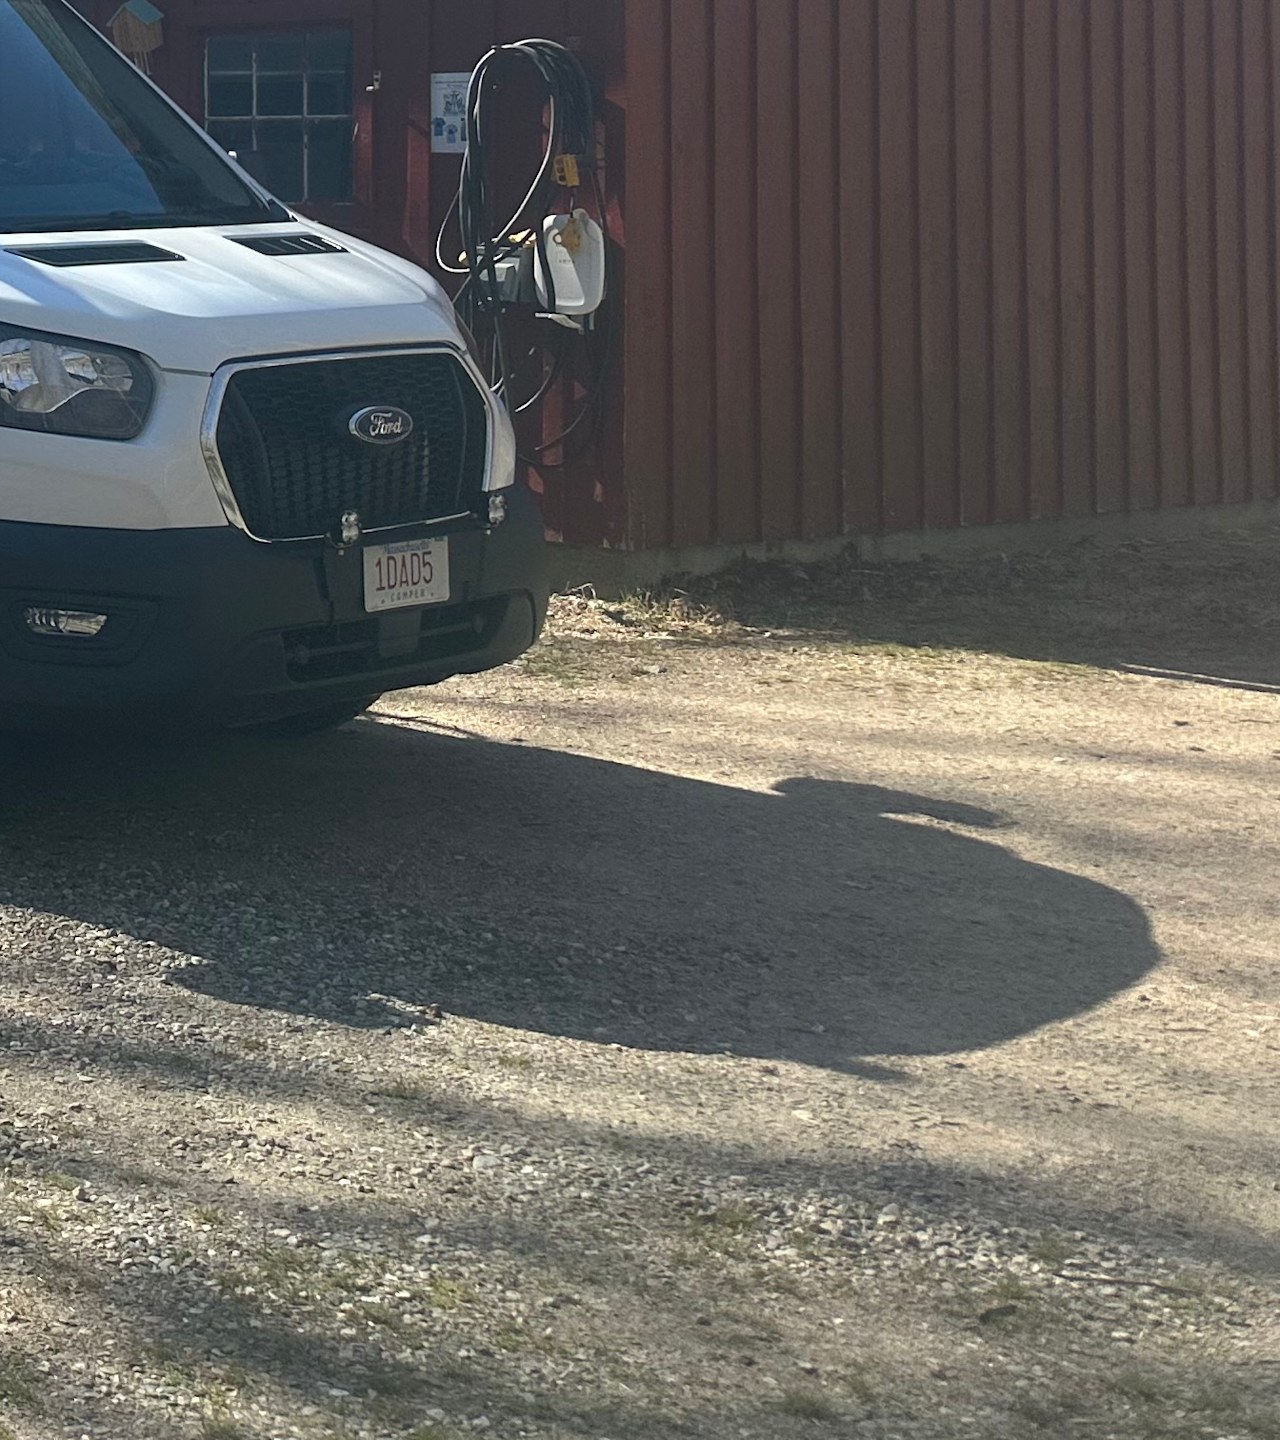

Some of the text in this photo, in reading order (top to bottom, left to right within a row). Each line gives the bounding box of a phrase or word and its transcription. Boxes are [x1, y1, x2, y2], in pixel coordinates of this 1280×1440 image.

[369, 412, 403, 437] Ford
[375, 550, 433, 592] 1DAD5
[390, 588, 426, 603] CAMPER
